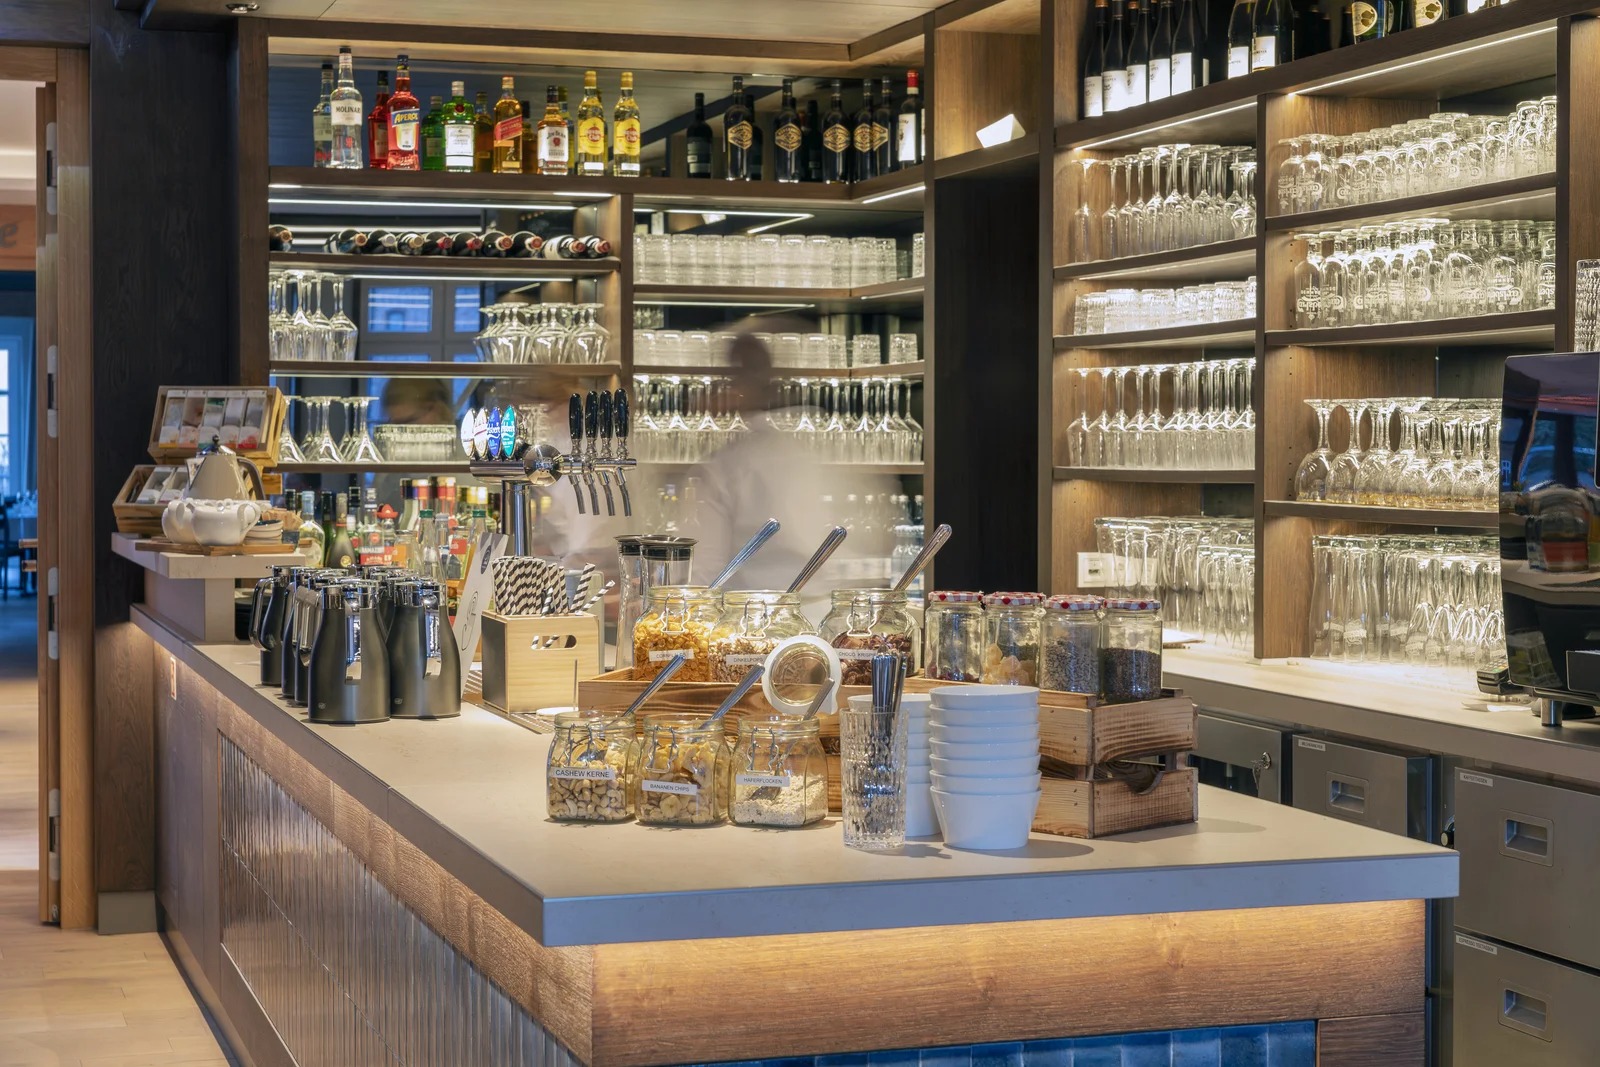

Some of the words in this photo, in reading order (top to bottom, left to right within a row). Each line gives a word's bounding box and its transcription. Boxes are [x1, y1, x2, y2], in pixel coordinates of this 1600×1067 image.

[555, 769, 585, 777] CASHEW
[586, 770, 610, 778] KERNE
[650, 783, 674, 791] BANANEN
